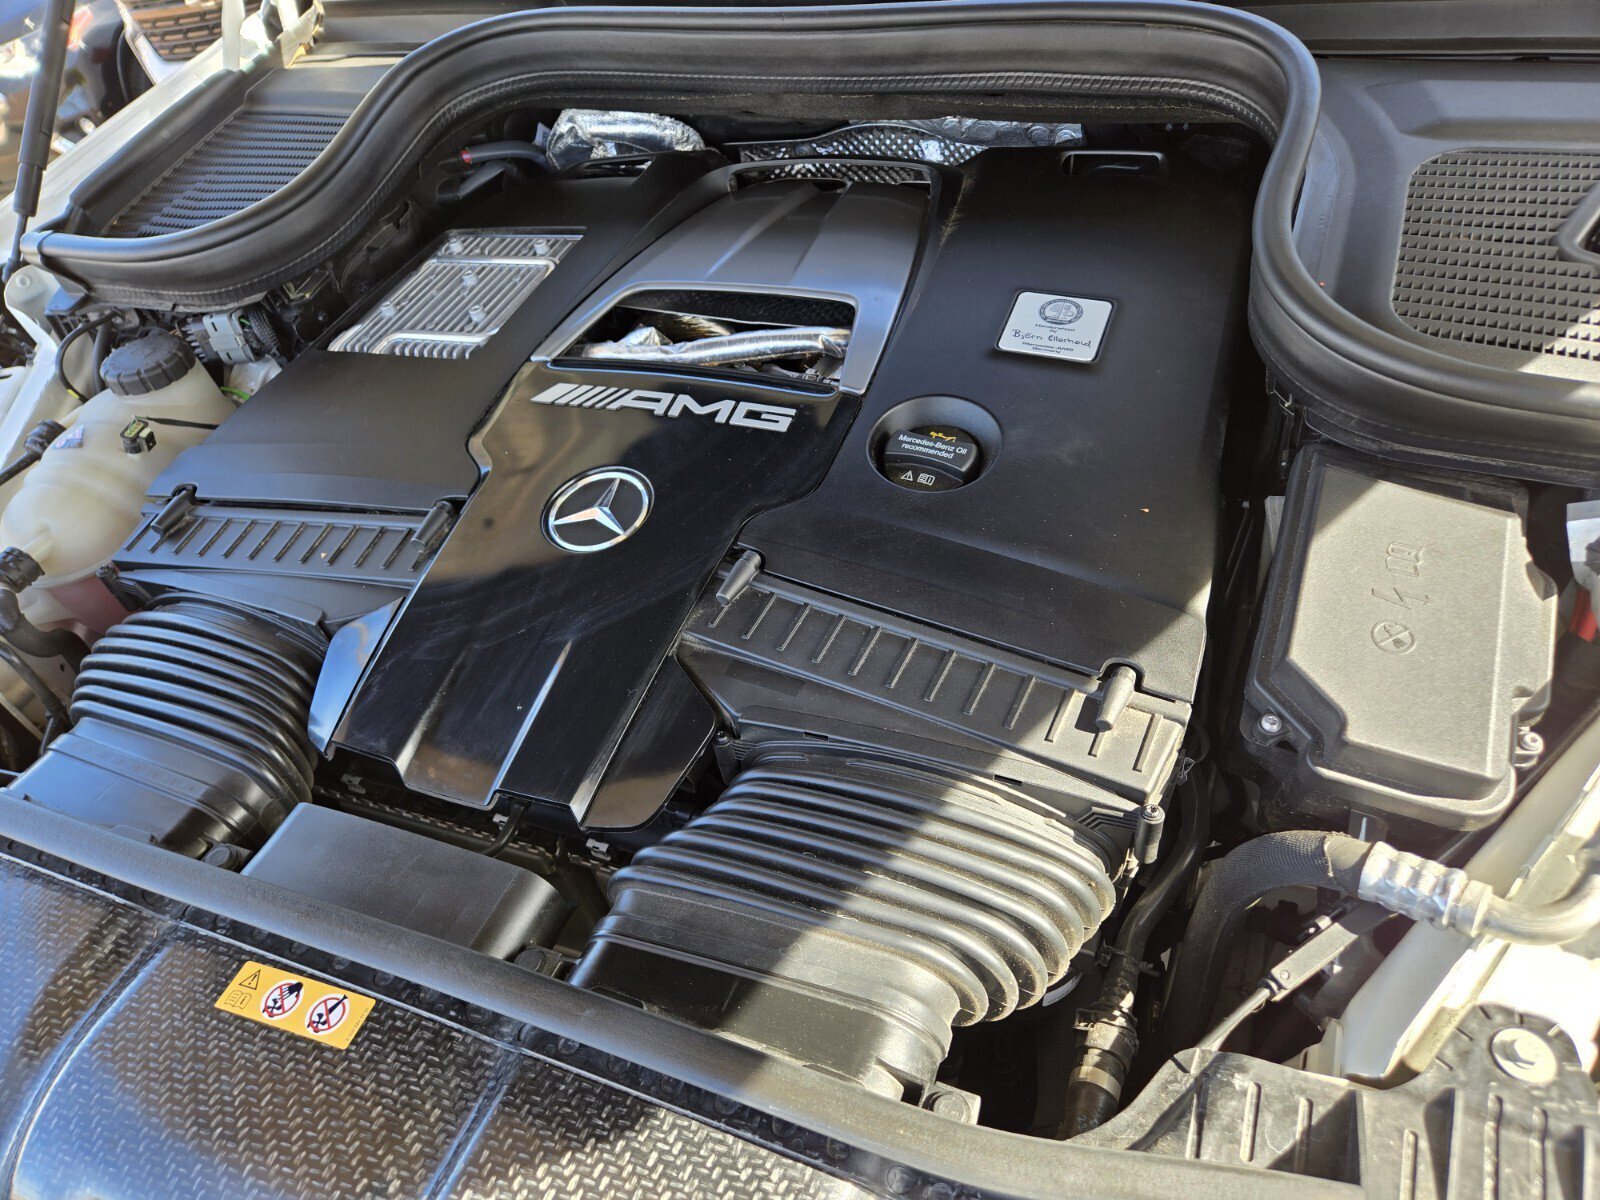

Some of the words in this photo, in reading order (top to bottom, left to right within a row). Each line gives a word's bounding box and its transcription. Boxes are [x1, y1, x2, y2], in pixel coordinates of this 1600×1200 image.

[1022, 341, 1074, 352] Mercedes-AMG
[606, 388, 797, 432] AMG
[898, 434, 955, 452] Mercedes-Benz
[955, 446, 968, 455] Oil
[901, 443, 954, 459] recommended
